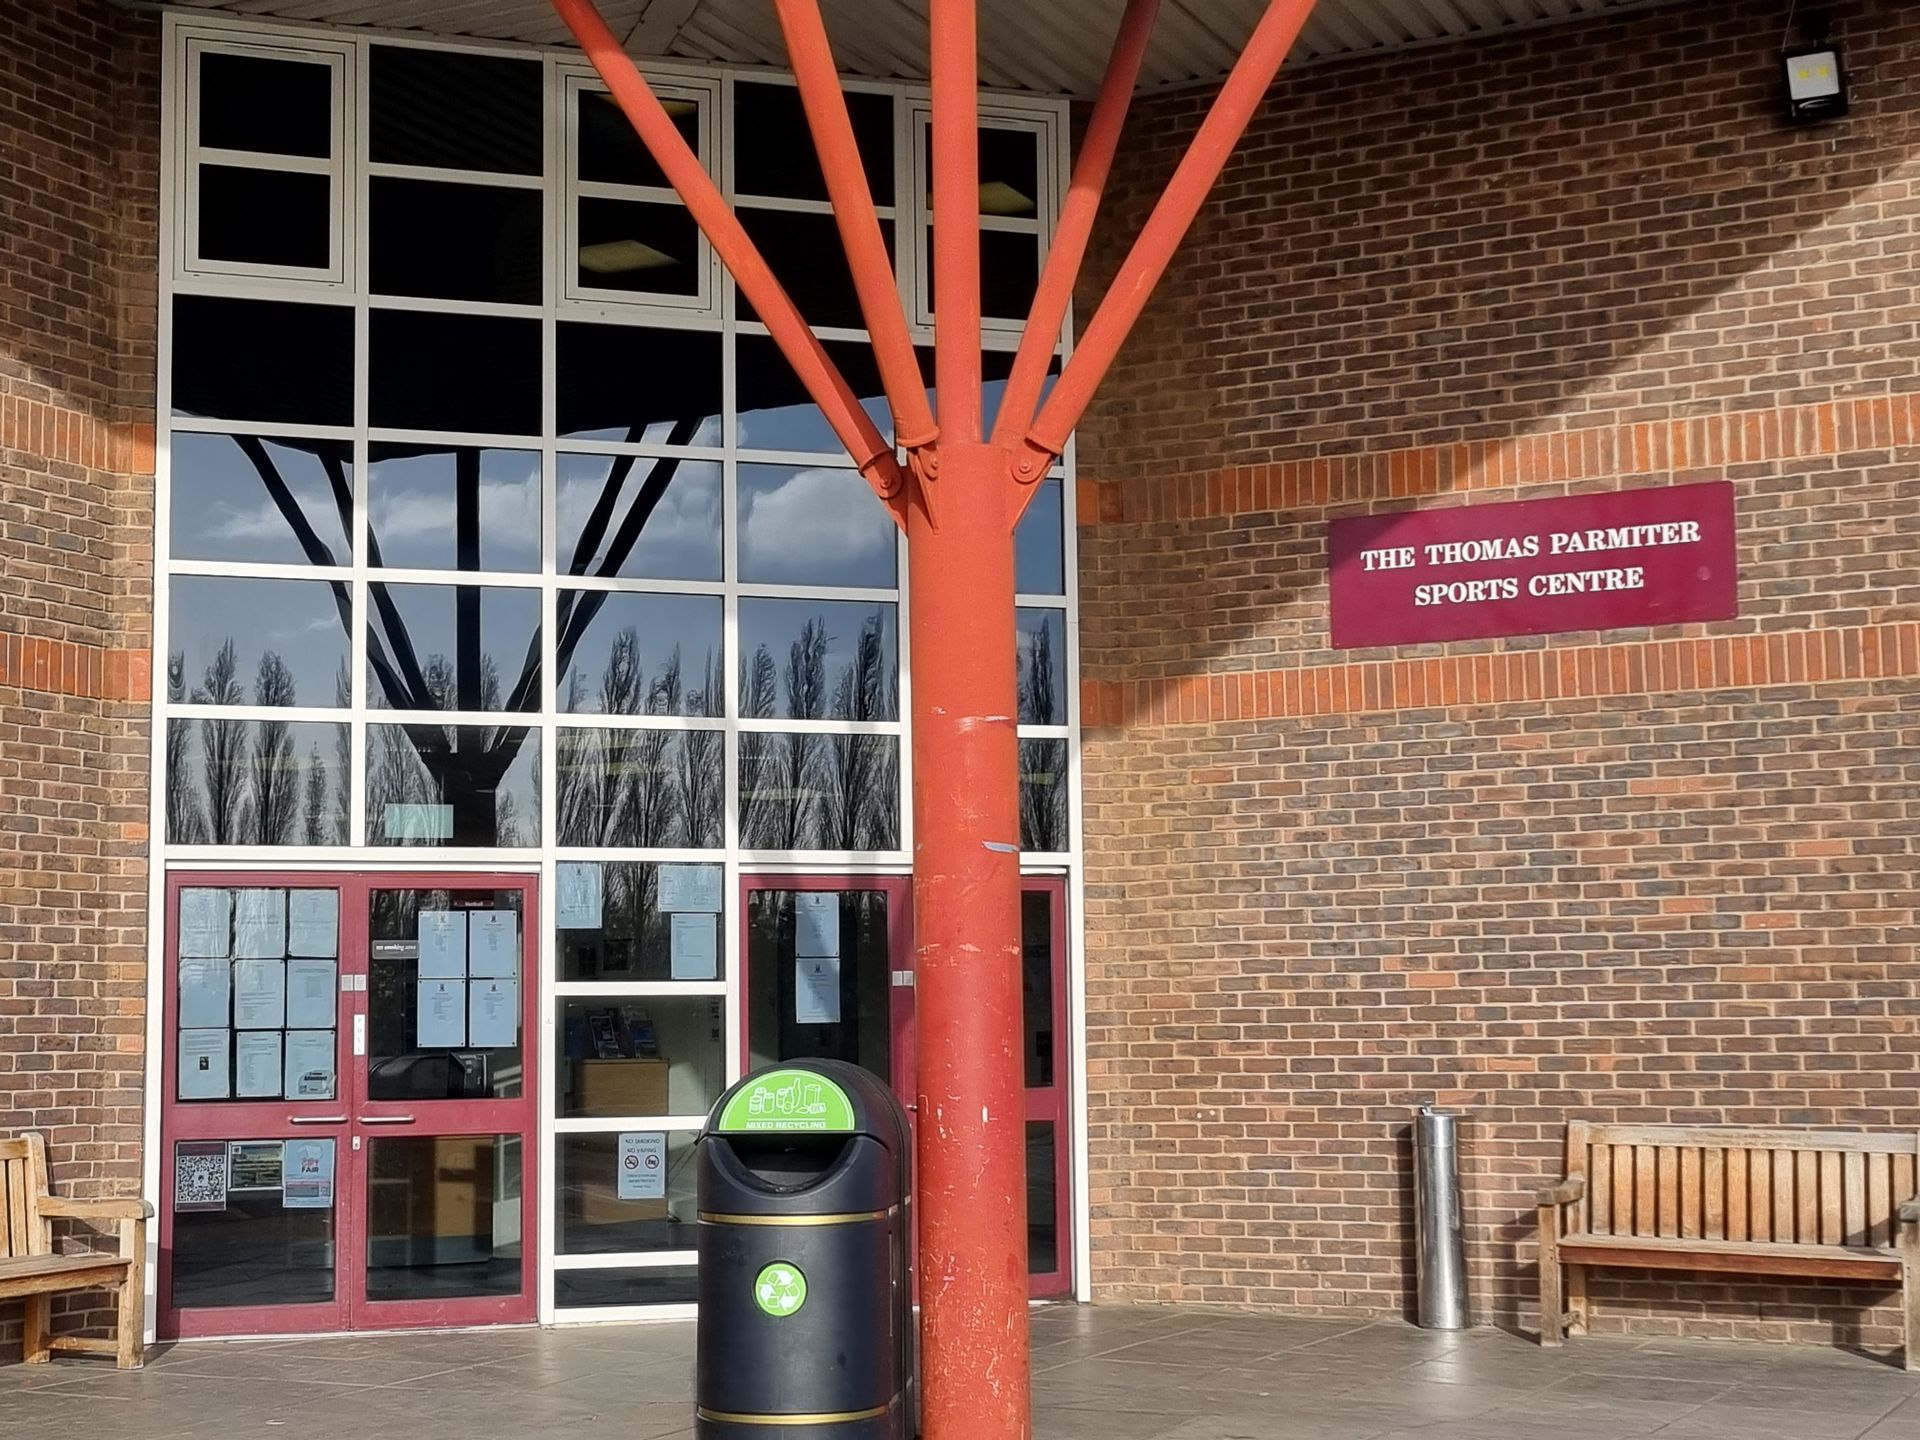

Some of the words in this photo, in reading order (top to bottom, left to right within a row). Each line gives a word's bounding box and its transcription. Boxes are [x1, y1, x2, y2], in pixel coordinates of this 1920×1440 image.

[1360, 546, 1416, 571] THE
[1425, 535, 1540, 566] THOMAS
[1550, 520, 1702, 554] PARMITER
[1414, 577, 1519, 606] SPORTS
[1528, 566, 1645, 597] CENTRE
[746, 1121, 774, 1129] MIXED
[776, 1121, 827, 1129] RECYCLING
